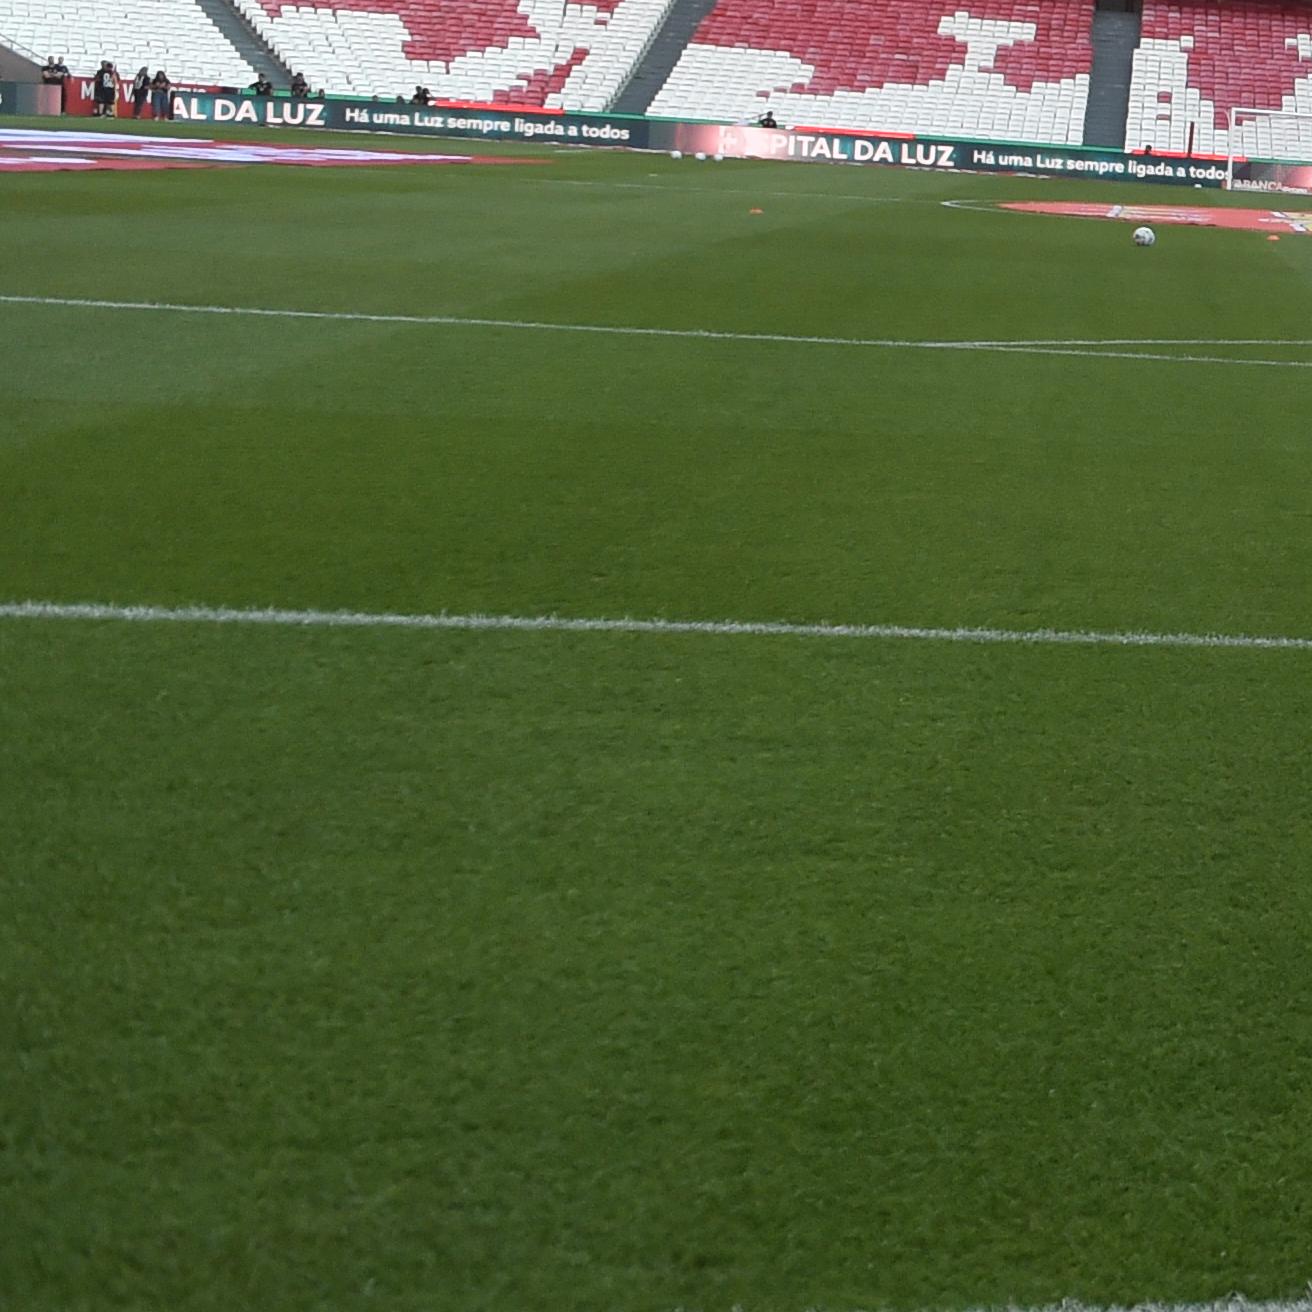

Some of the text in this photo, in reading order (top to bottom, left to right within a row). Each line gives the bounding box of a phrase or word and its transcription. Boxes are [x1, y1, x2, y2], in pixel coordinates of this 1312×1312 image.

[214, 98, 259, 124] DA
[266, 102, 326, 127] LUZ
[346, 107, 630, 141] Há uma Luz sempre ligada a todos
[854, 139, 894, 163] DA
[901, 143, 955, 167] LUZ
[973, 149, 995, 165] Há
[998, 154, 1033, 168] uma
[1036, 154, 1063, 170] Luz
[1066, 158, 1125, 176] sempre
[1128, 160, 1173, 179] ligada
[1176, 167, 1187, 178] a
